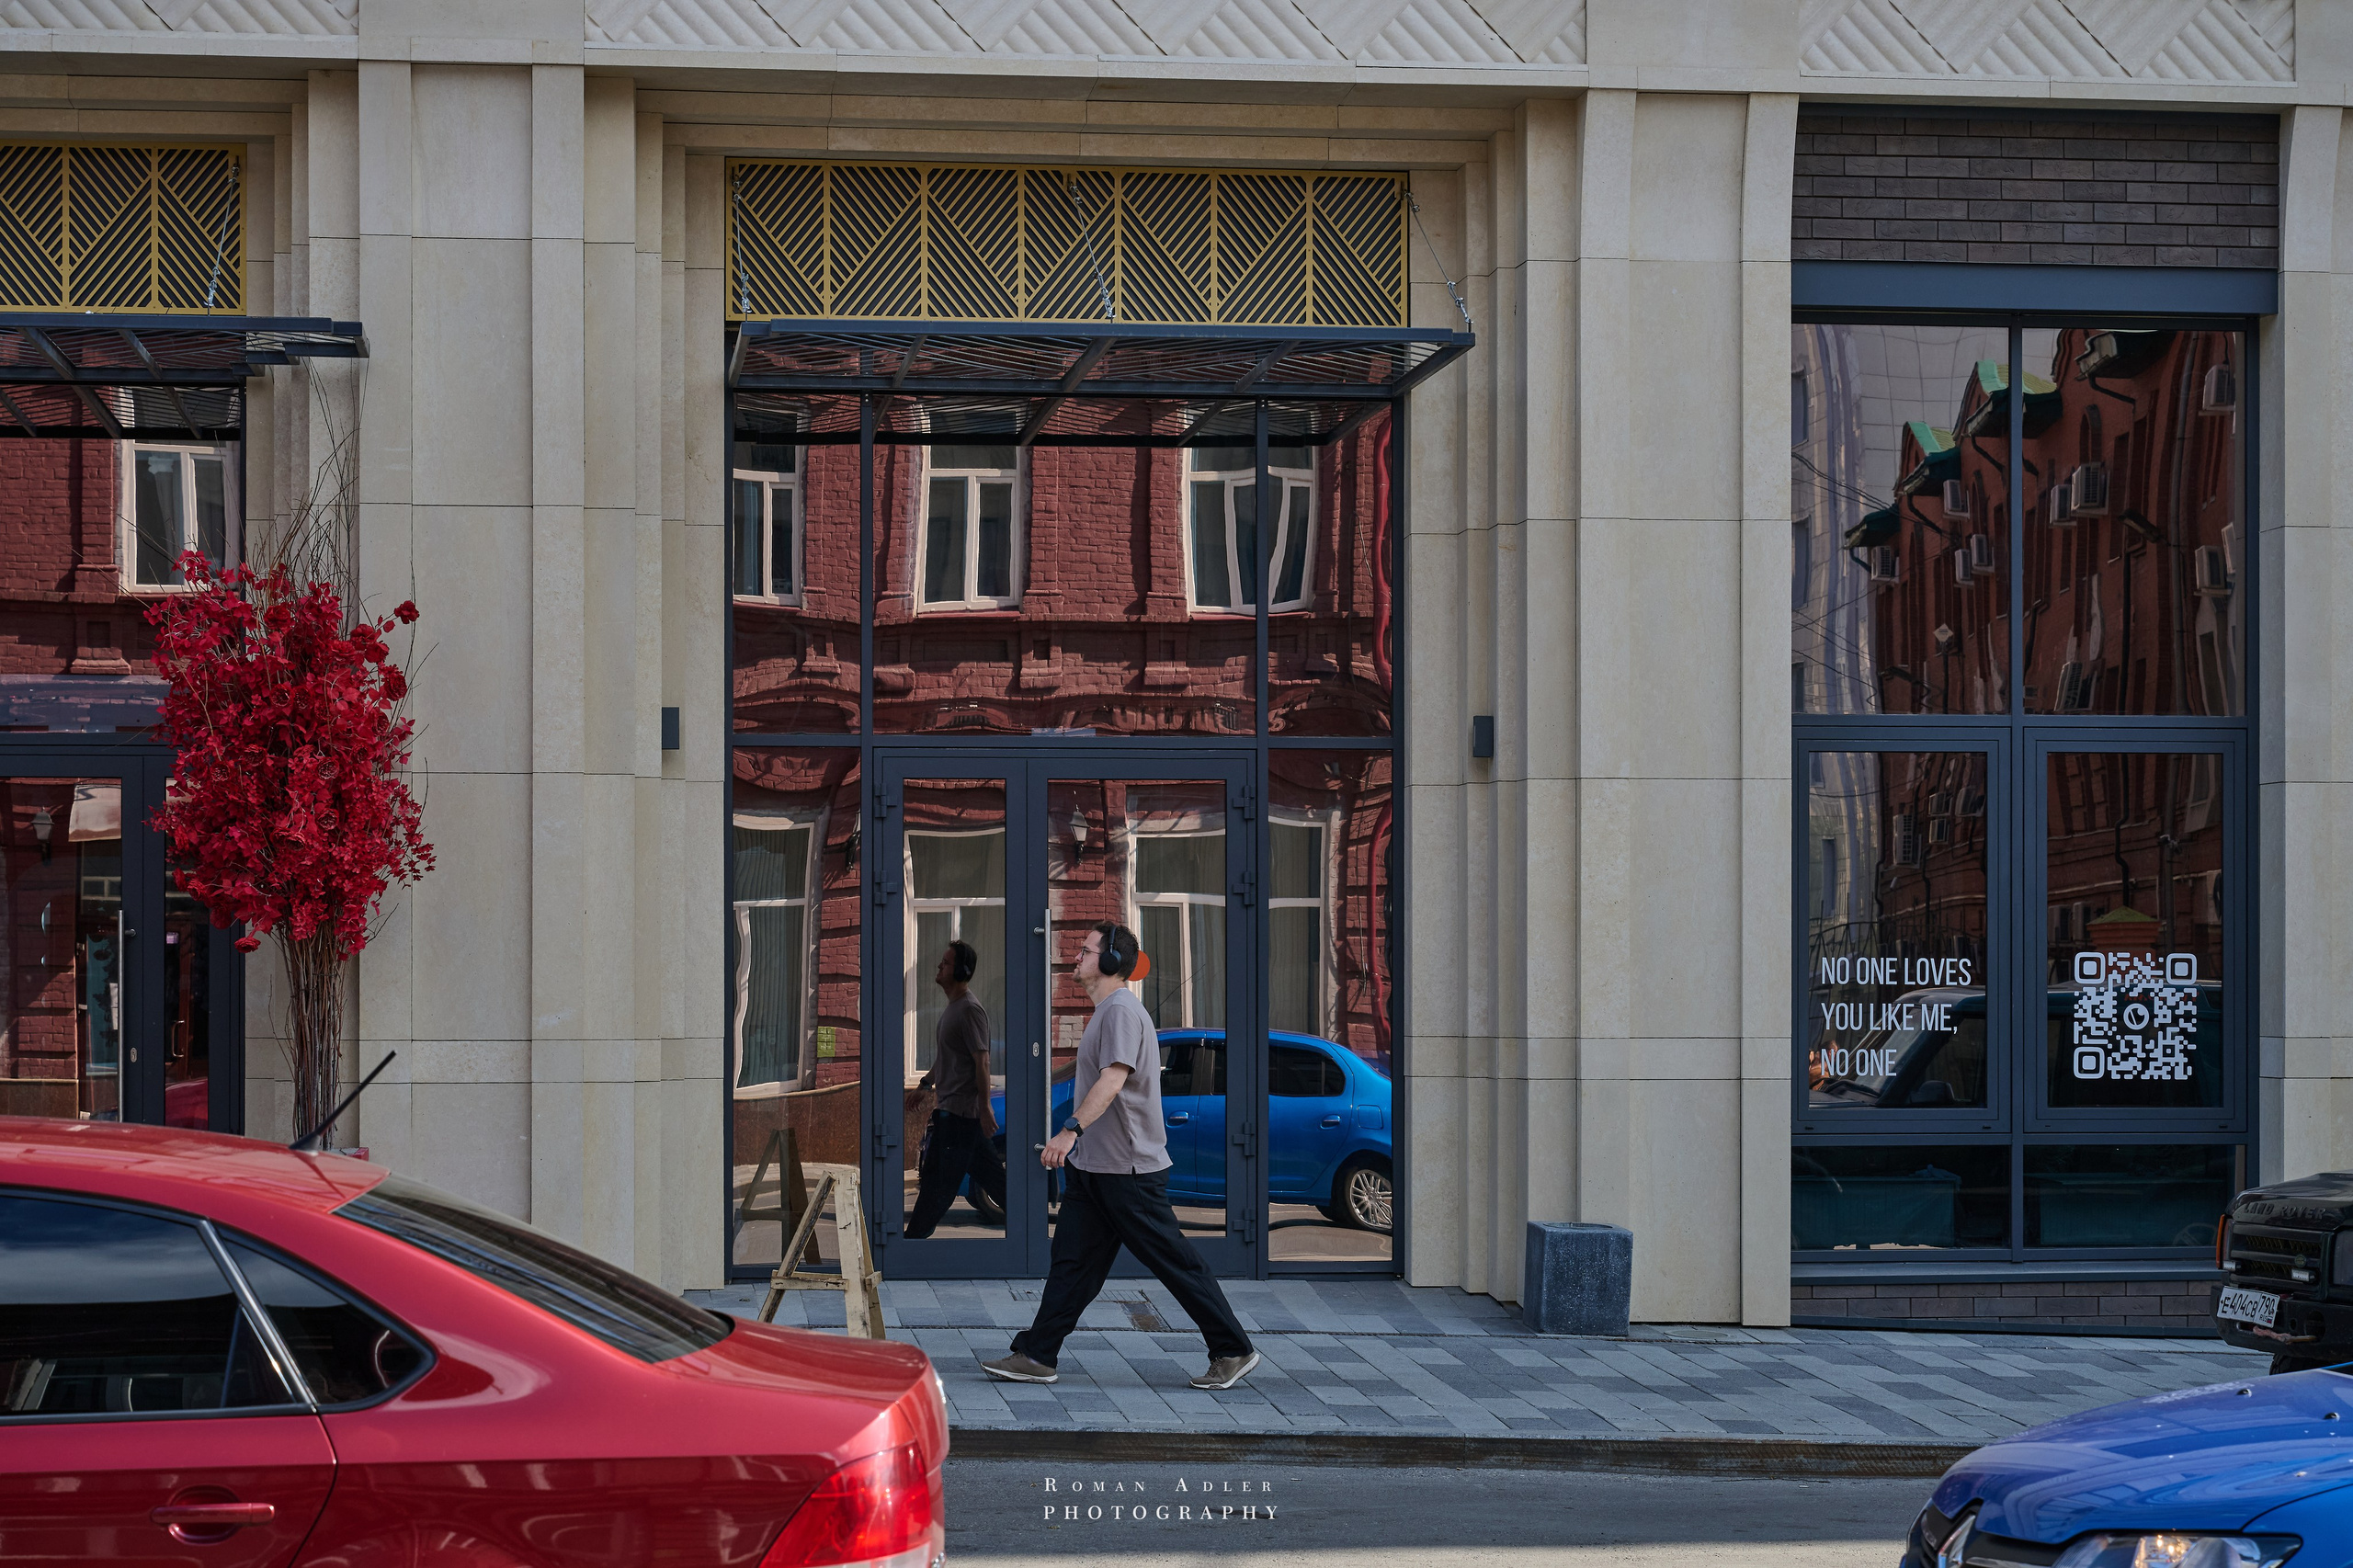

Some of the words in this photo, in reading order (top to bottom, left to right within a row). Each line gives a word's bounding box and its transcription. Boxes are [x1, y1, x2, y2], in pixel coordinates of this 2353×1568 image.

[1821, 957, 1850, 985] NO
[1856, 957, 1898, 985] ONE
[1904, 958, 1972, 986] LOVES
[1821, 1003, 1863, 1031] YOU
[1870, 1003, 1915, 1031] LIKE
[1921, 1003, 1958, 1035] ME,
[1821, 1048, 1849, 1076] NO
[1855, 1049, 1897, 1076] ONE
[2244, 1201, 2275, 1215] LAND
[2279, 1205, 2326, 1220] ROVER
